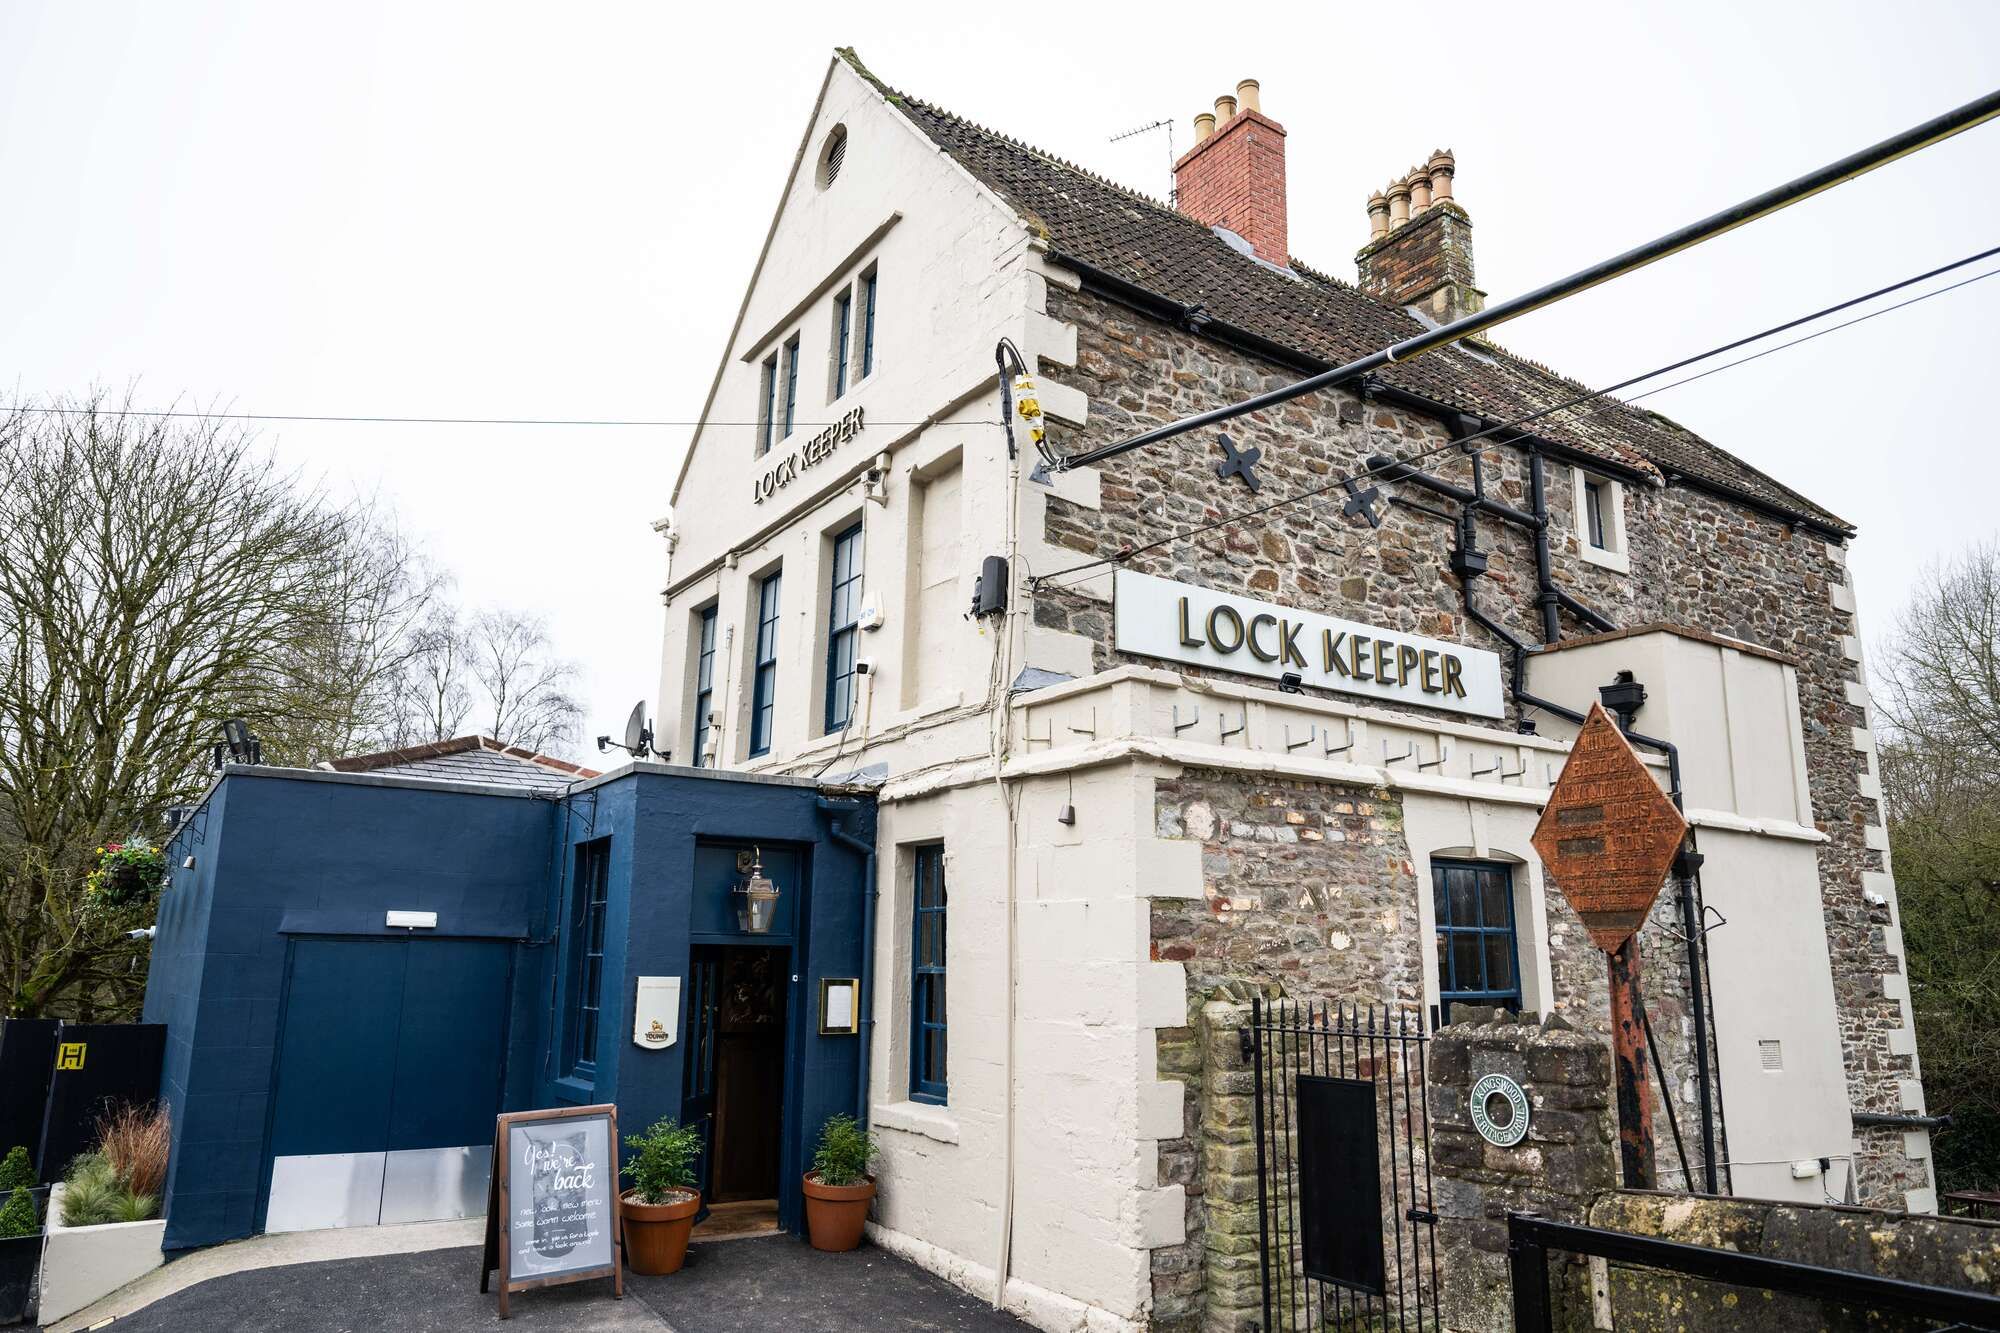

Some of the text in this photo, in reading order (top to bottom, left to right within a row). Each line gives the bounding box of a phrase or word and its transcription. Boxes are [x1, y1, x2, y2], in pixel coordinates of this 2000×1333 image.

[754, 405, 864, 505] LOCK KEEPER
[1179, 597, 1467, 698] LOCK KEEPER
[61, 1045, 83, 1067] H
[1475, 1078, 1521, 1103] KINGSWOOD
[1473, 1105, 1525, 1142] HERITAGE TRAIL
[554, 1162, 596, 1191] back
